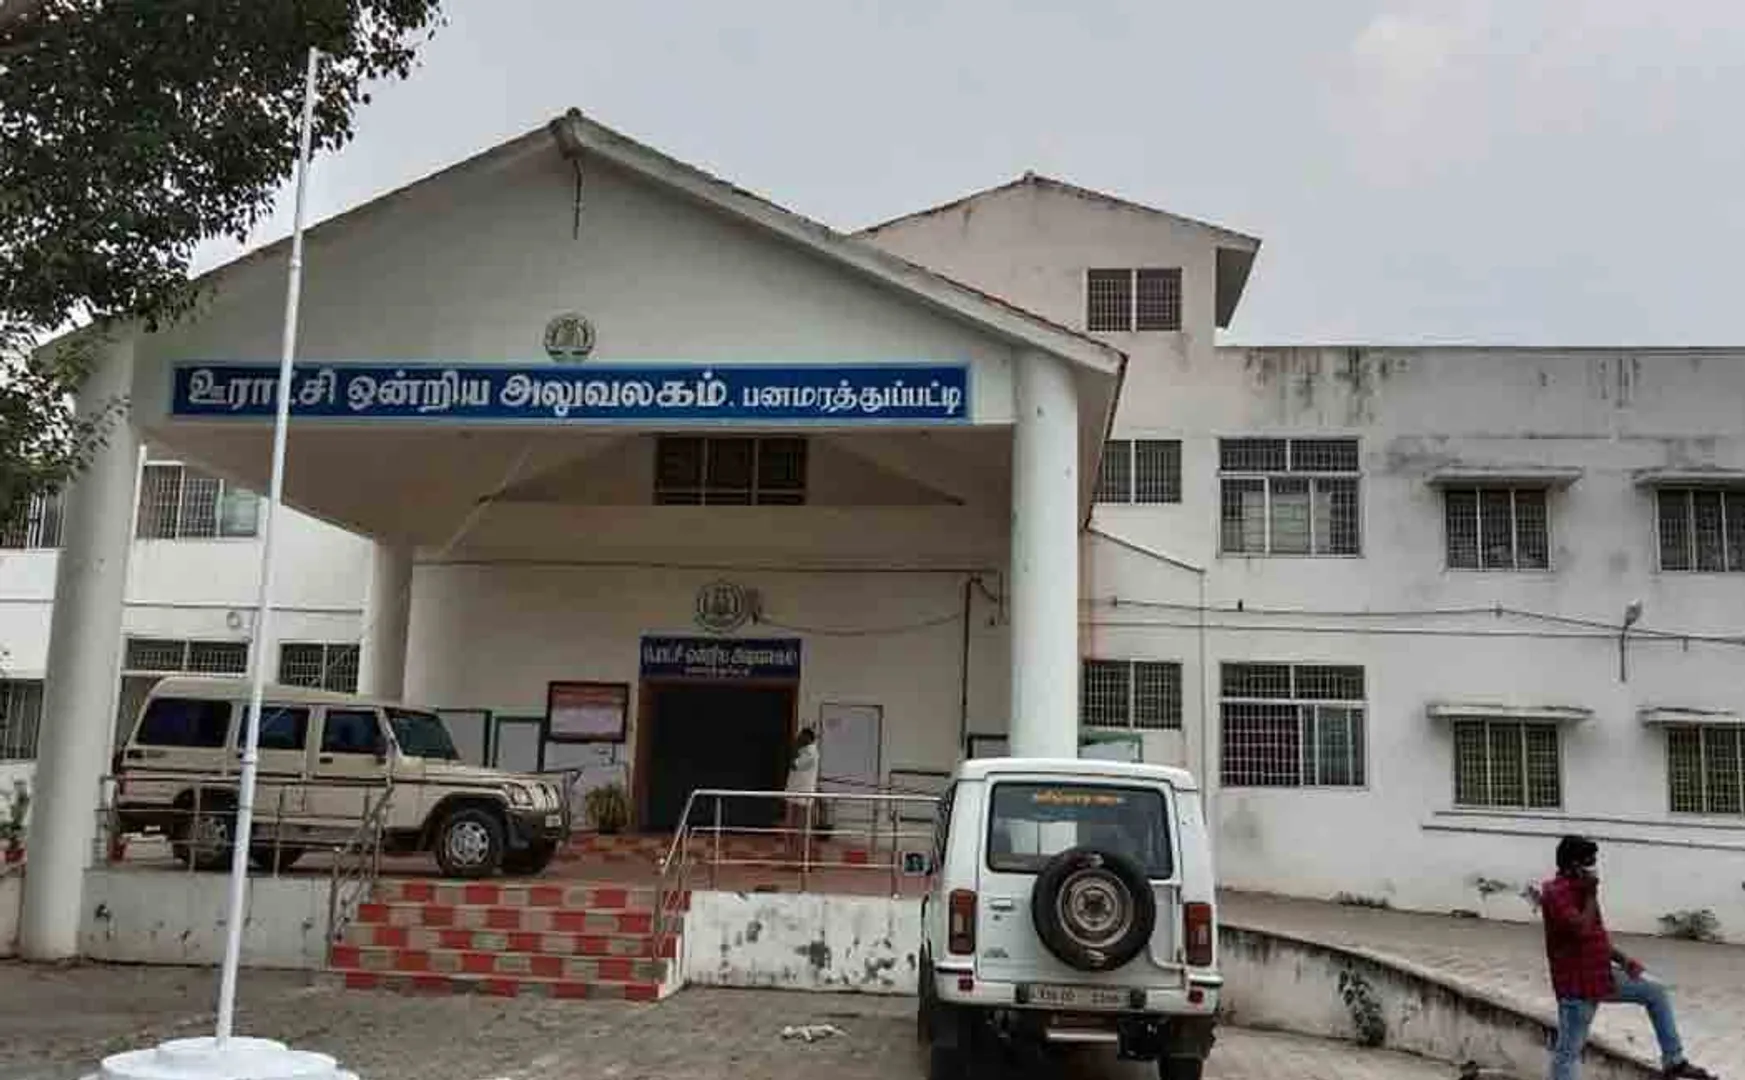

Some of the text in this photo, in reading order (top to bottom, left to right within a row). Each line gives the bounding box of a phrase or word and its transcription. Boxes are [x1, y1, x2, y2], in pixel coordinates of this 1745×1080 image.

[188, 369, 336, 410] ஊரா்சி
[347, 369, 490, 412] ஒன்றிய
[742, 379, 962, 414] பனமரத்துப்பட்டி
